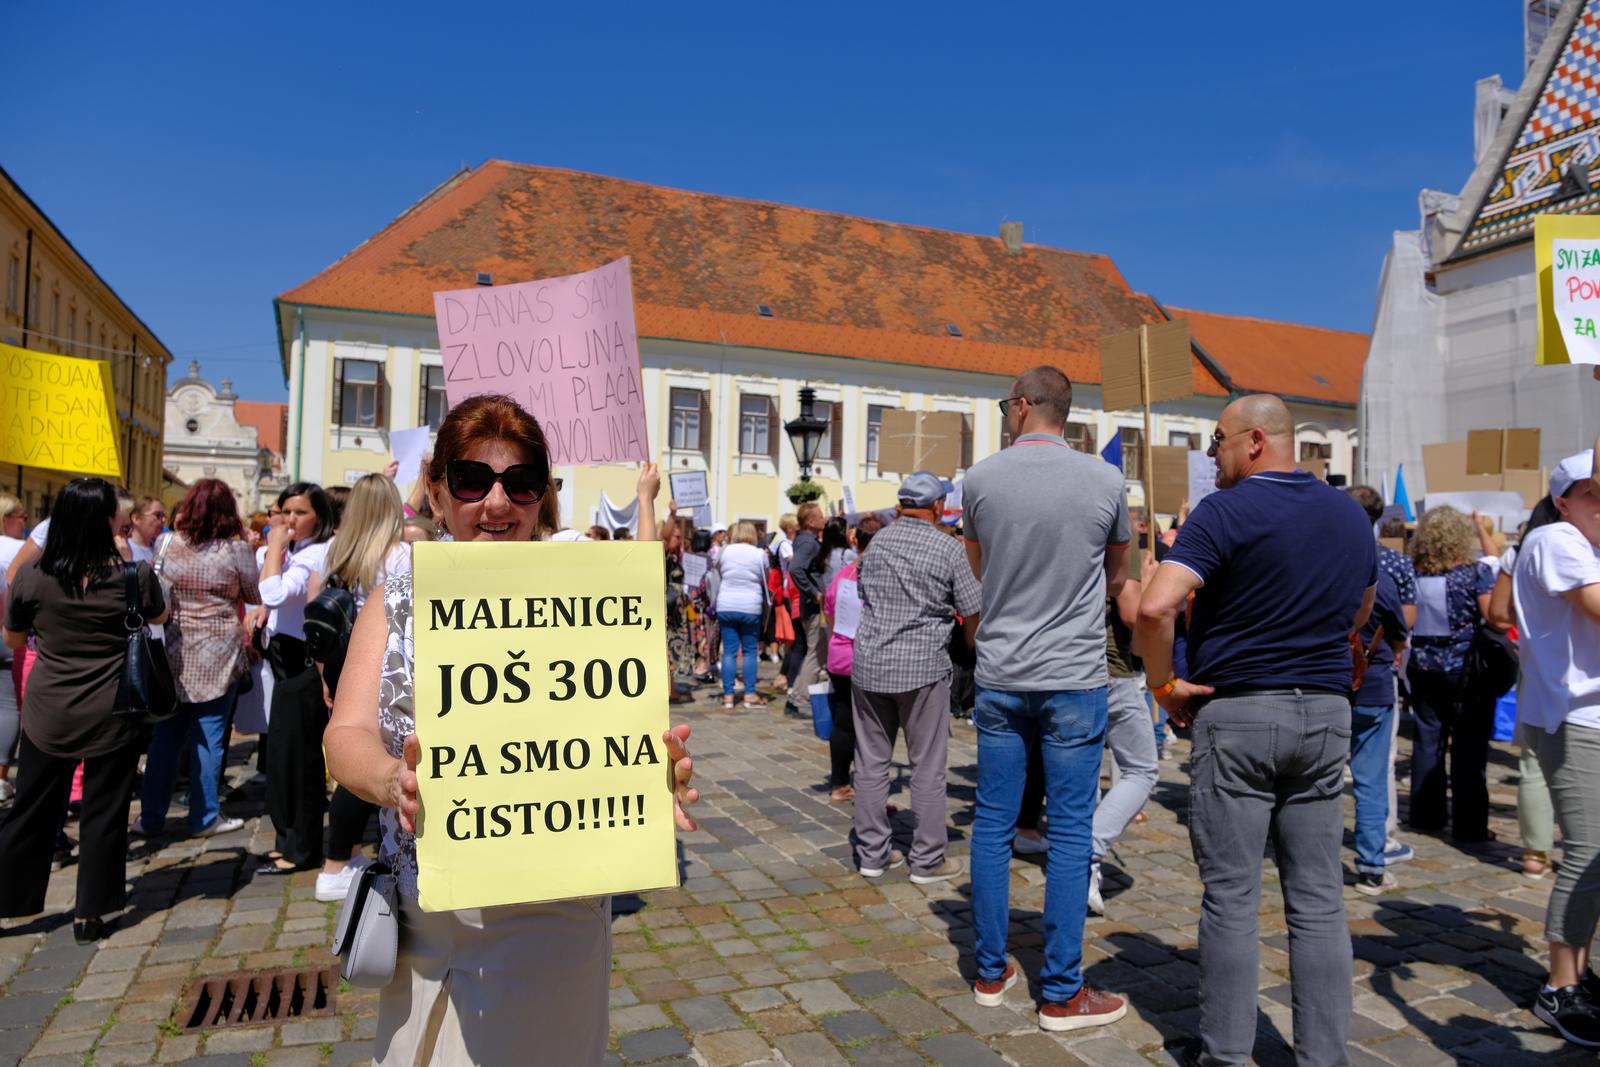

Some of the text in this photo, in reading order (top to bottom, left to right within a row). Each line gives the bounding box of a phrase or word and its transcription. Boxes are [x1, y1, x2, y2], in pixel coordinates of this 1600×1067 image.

[1557, 248, 1578, 270] SVI
[445, 271, 619, 335] DANAS SAM
[446, 320, 628, 382] ZLOVOLJNA
[529, 366, 641, 417] MI PLAĆA
[429, 596, 652, 631] MALENICE,
[437, 650, 647, 718] JOŠ 300
[429, 734, 660, 779] PA SMO NA
[446, 794, 645, 840] ČISTO!!!!!
